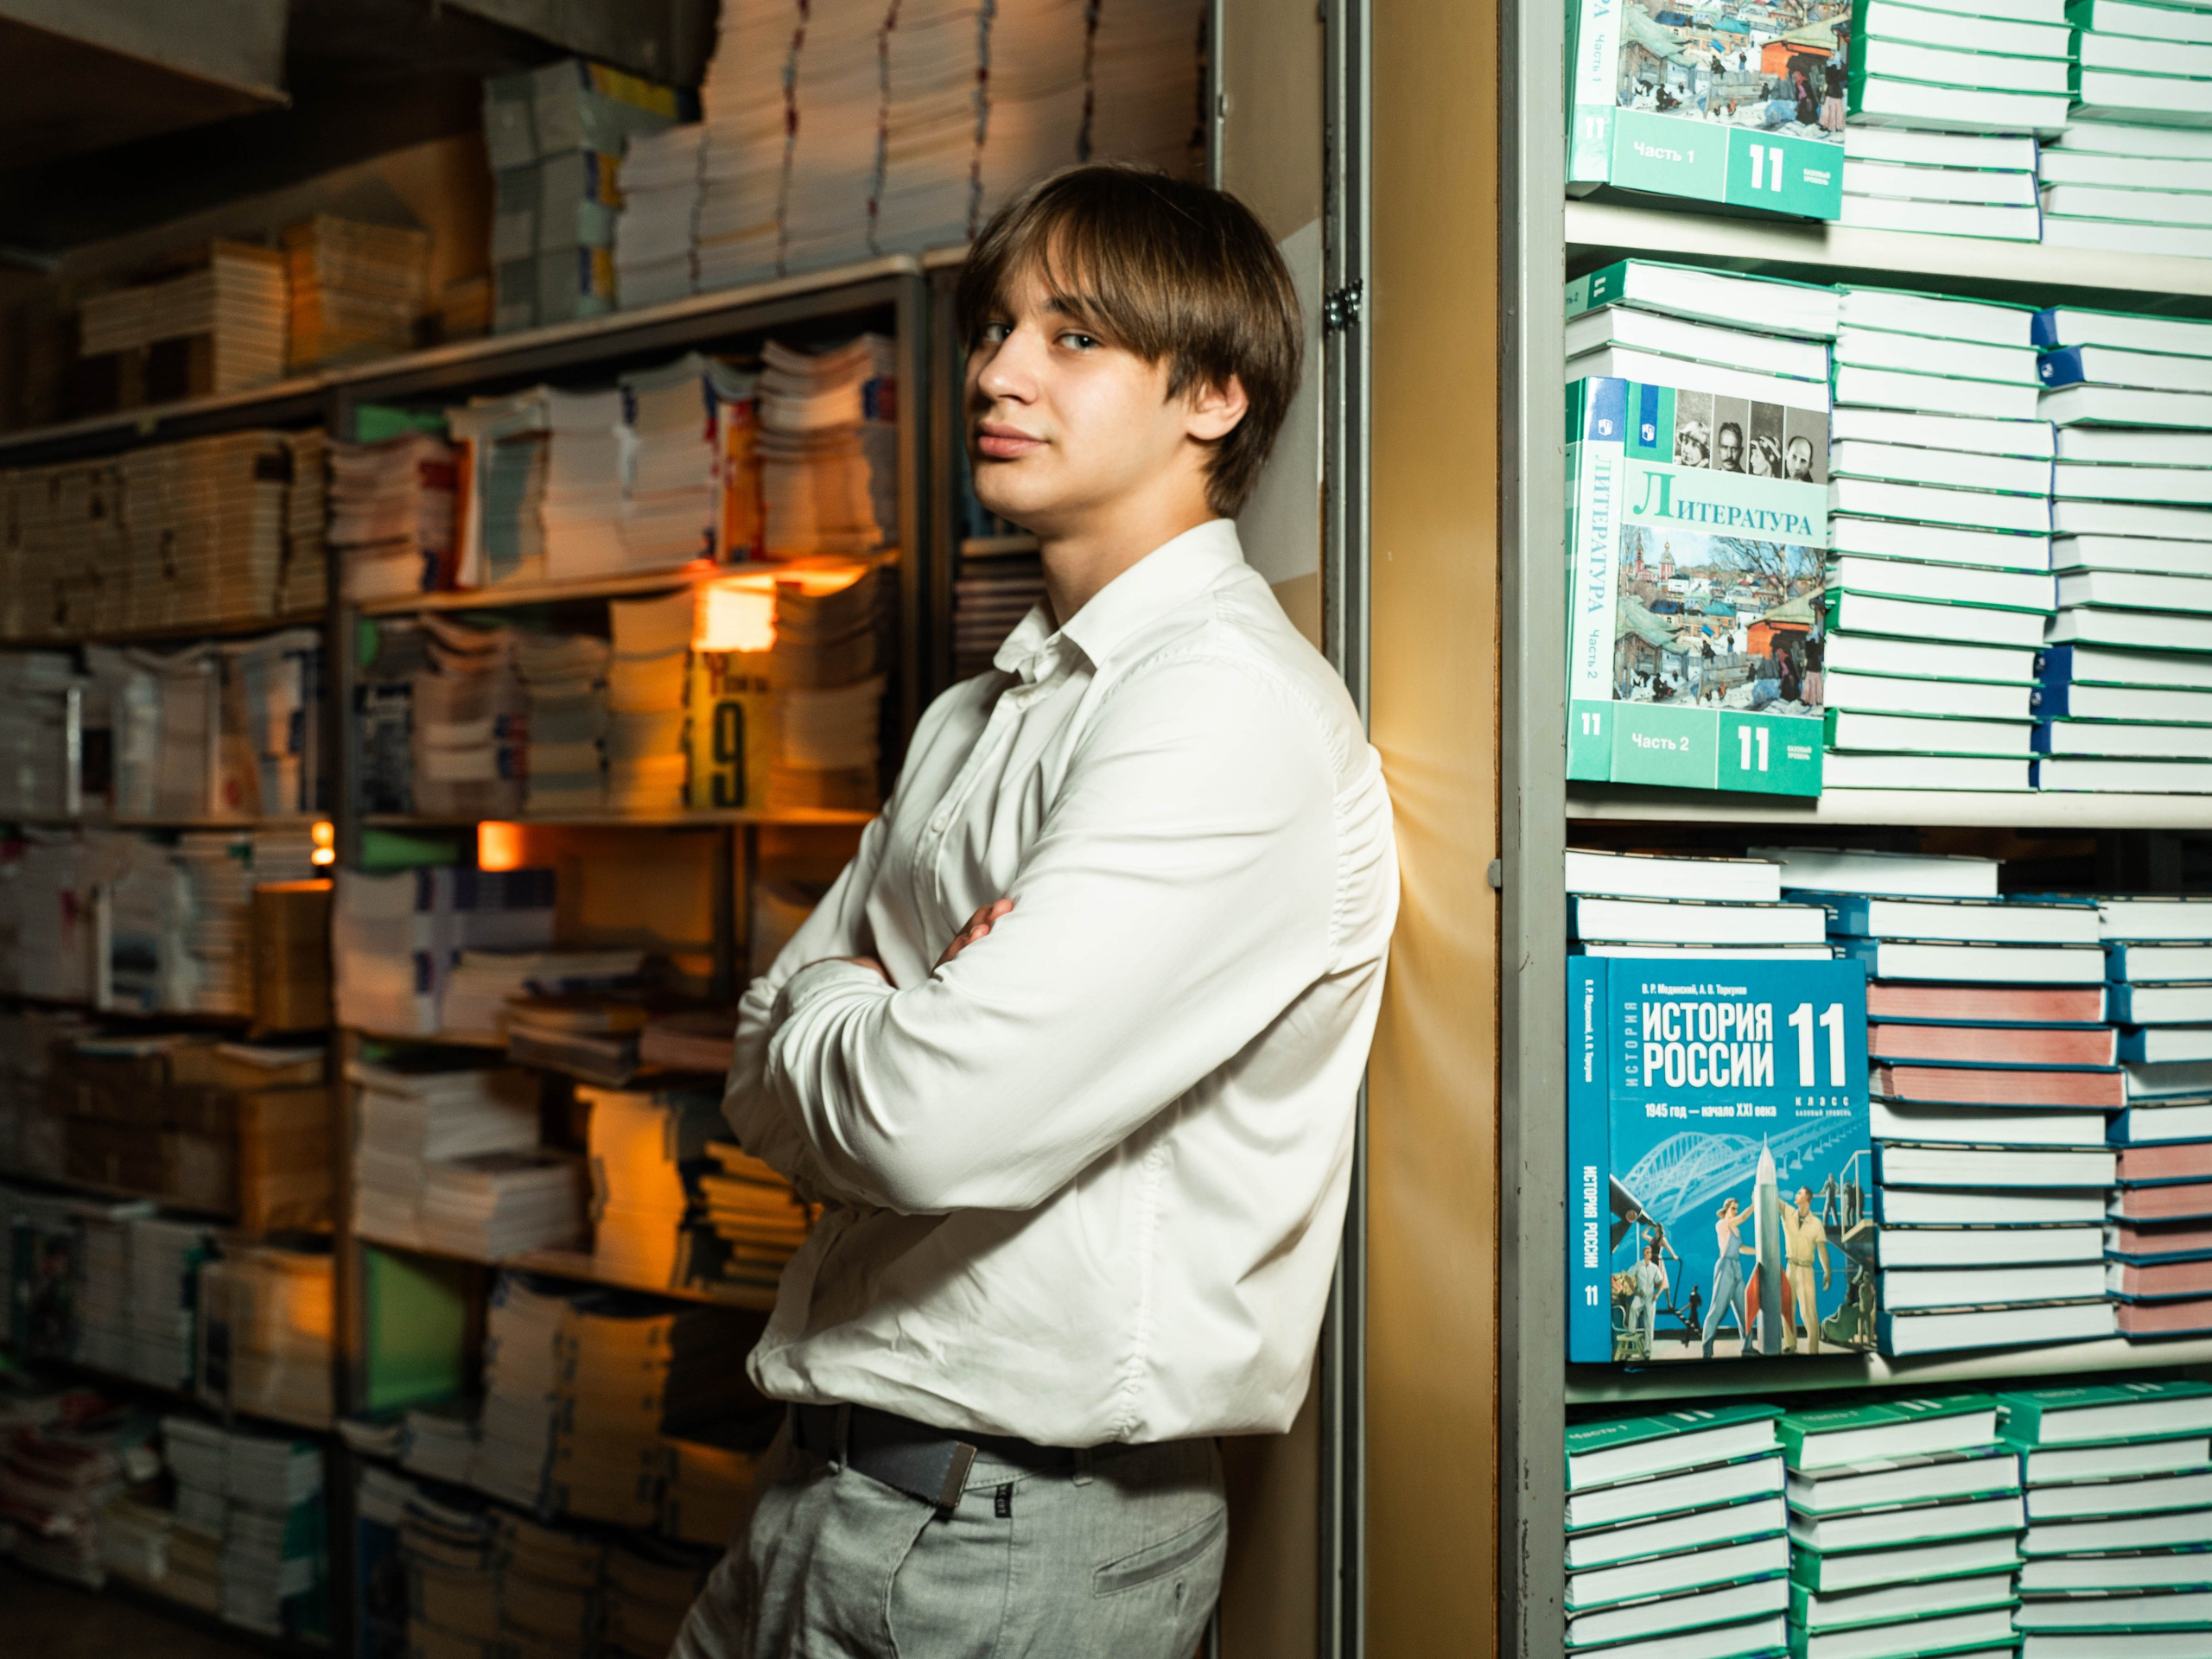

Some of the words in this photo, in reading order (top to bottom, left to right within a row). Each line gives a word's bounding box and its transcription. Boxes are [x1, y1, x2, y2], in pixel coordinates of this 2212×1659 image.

[1592, 35, 1605, 72] Часть
[1586, 117, 1605, 139] 11
[1633, 141, 1682, 162] Часть
[1687, 149, 1695, 163] 1
[1750, 143, 1784, 193] 11
[1593, 276, 1606, 298] 11
[1588, 454, 1611, 613] ЛИТЕРАТУРА
[1588, 629, 1599, 668] Часть
[1581, 713, 1600, 735] 11
[1632, 733, 1676, 750] Часть
[1680, 737, 1689, 751] 2
[713, 702, 745, 807] 9
[1738, 725, 1769, 772] 11
[1642, 983, 1649, 995] В.
[1650, 983, 1656, 995] Р.
[1657, 983, 1699, 995] Мединский,
[1699, 984, 1707, 995] А.
[1707, 984, 1714, 995] В.
[1716, 984, 1747, 996] Торкунов
[1643, 1001, 1773, 1042] ИСТОРИЯ
[1624, 1002, 1638, 1087] ИСТОРИЯ
[1643, 1042, 1774, 1087] РОССИИ
[1788, 1002, 1846, 1087] 11
[1645, 1103, 1668, 1118] 1945
[1669, 1105, 1688, 1119] год
[1701, 1105, 1734, 1118] начало
[1754, 1105, 1777, 1117] века
[1583, 1166, 1598, 1218] ИСТОРИЯ
[1584, 1222, 1599, 1268] РОССИИ
[1585, 1285, 1599, 1306] 11
